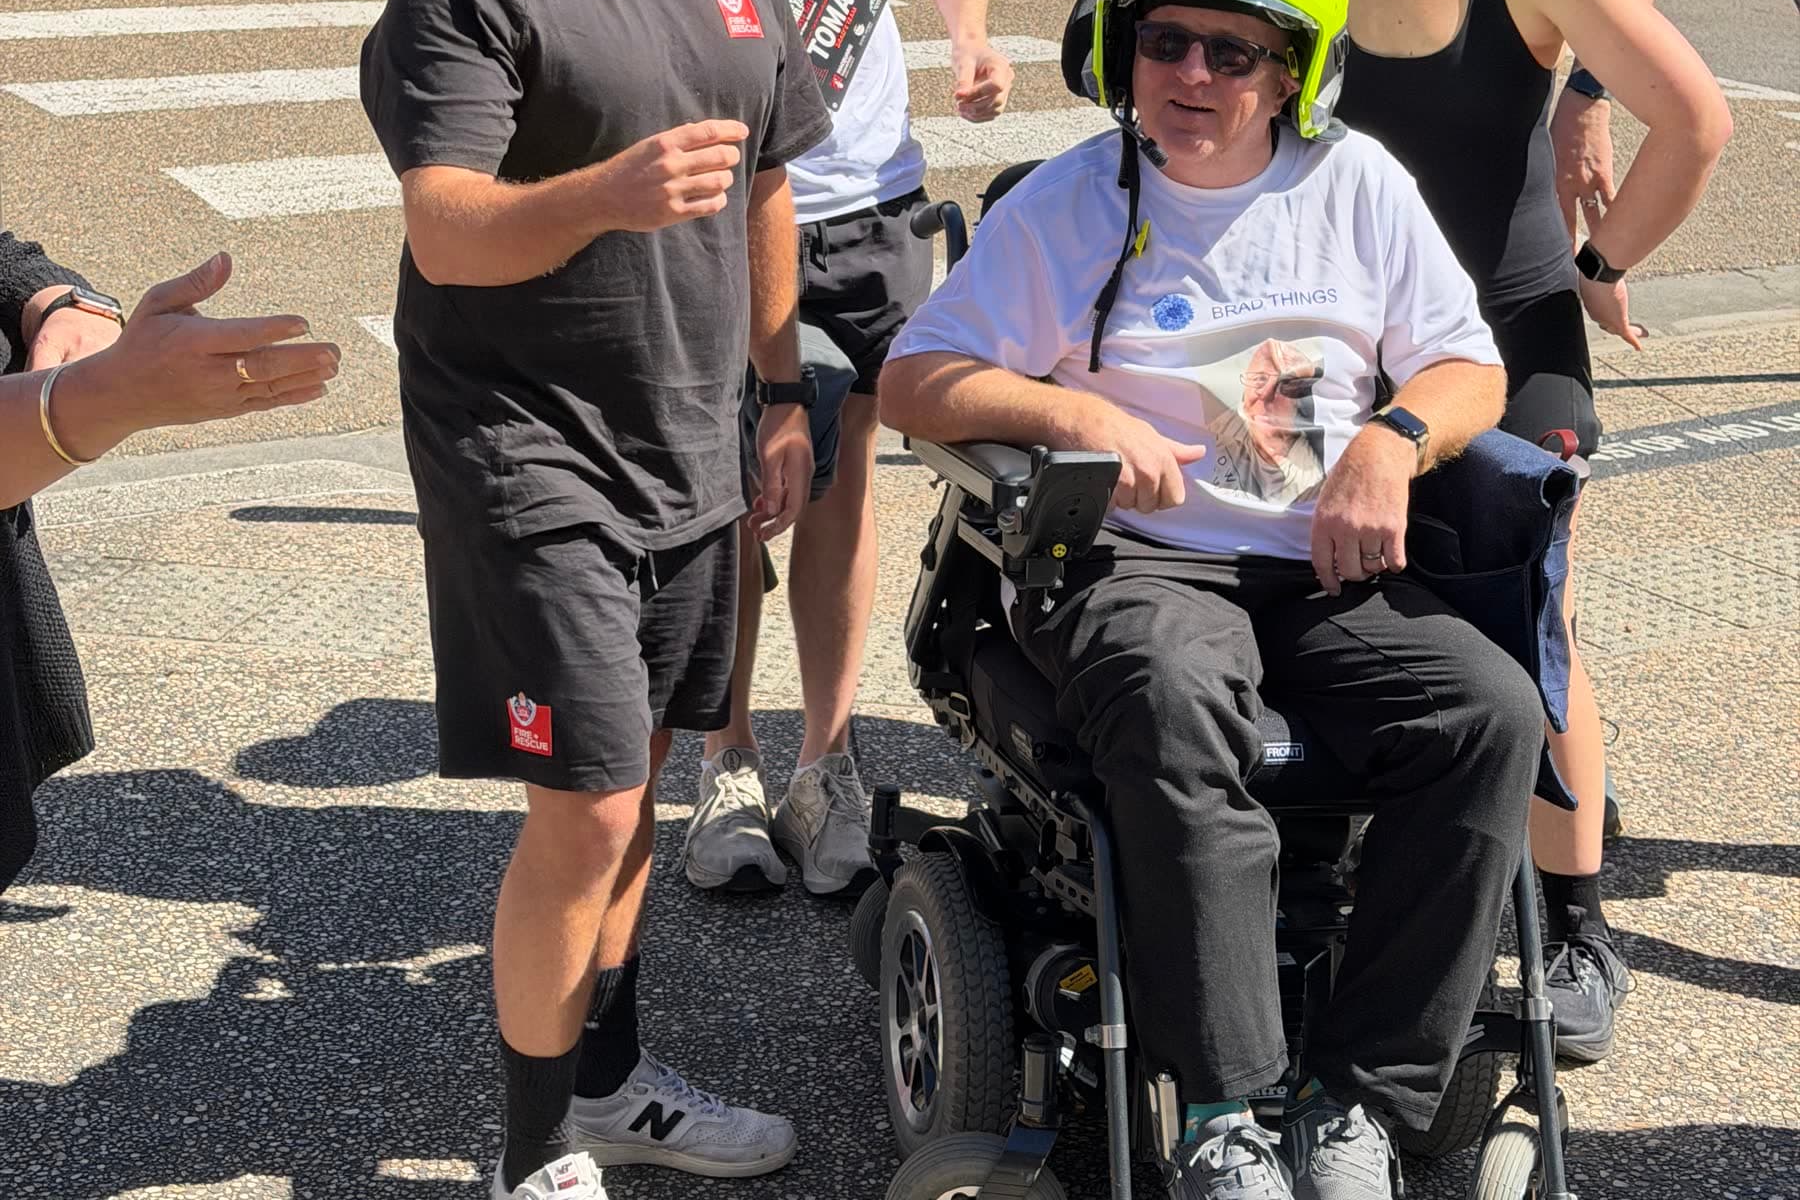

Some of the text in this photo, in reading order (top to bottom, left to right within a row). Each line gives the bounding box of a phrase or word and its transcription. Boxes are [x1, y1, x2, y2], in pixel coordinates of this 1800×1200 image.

[728, 16, 746, 25] FIRE
[731, 24, 761, 33] RESCUE
[1211, 288, 1338, 320] BRAD THINGS
[1683, 423, 1770, 445] AND
[514, 727, 532, 739] FIRE
[514, 735, 549, 751] RESCUE
[1266, 747, 1300, 757] FRONT
